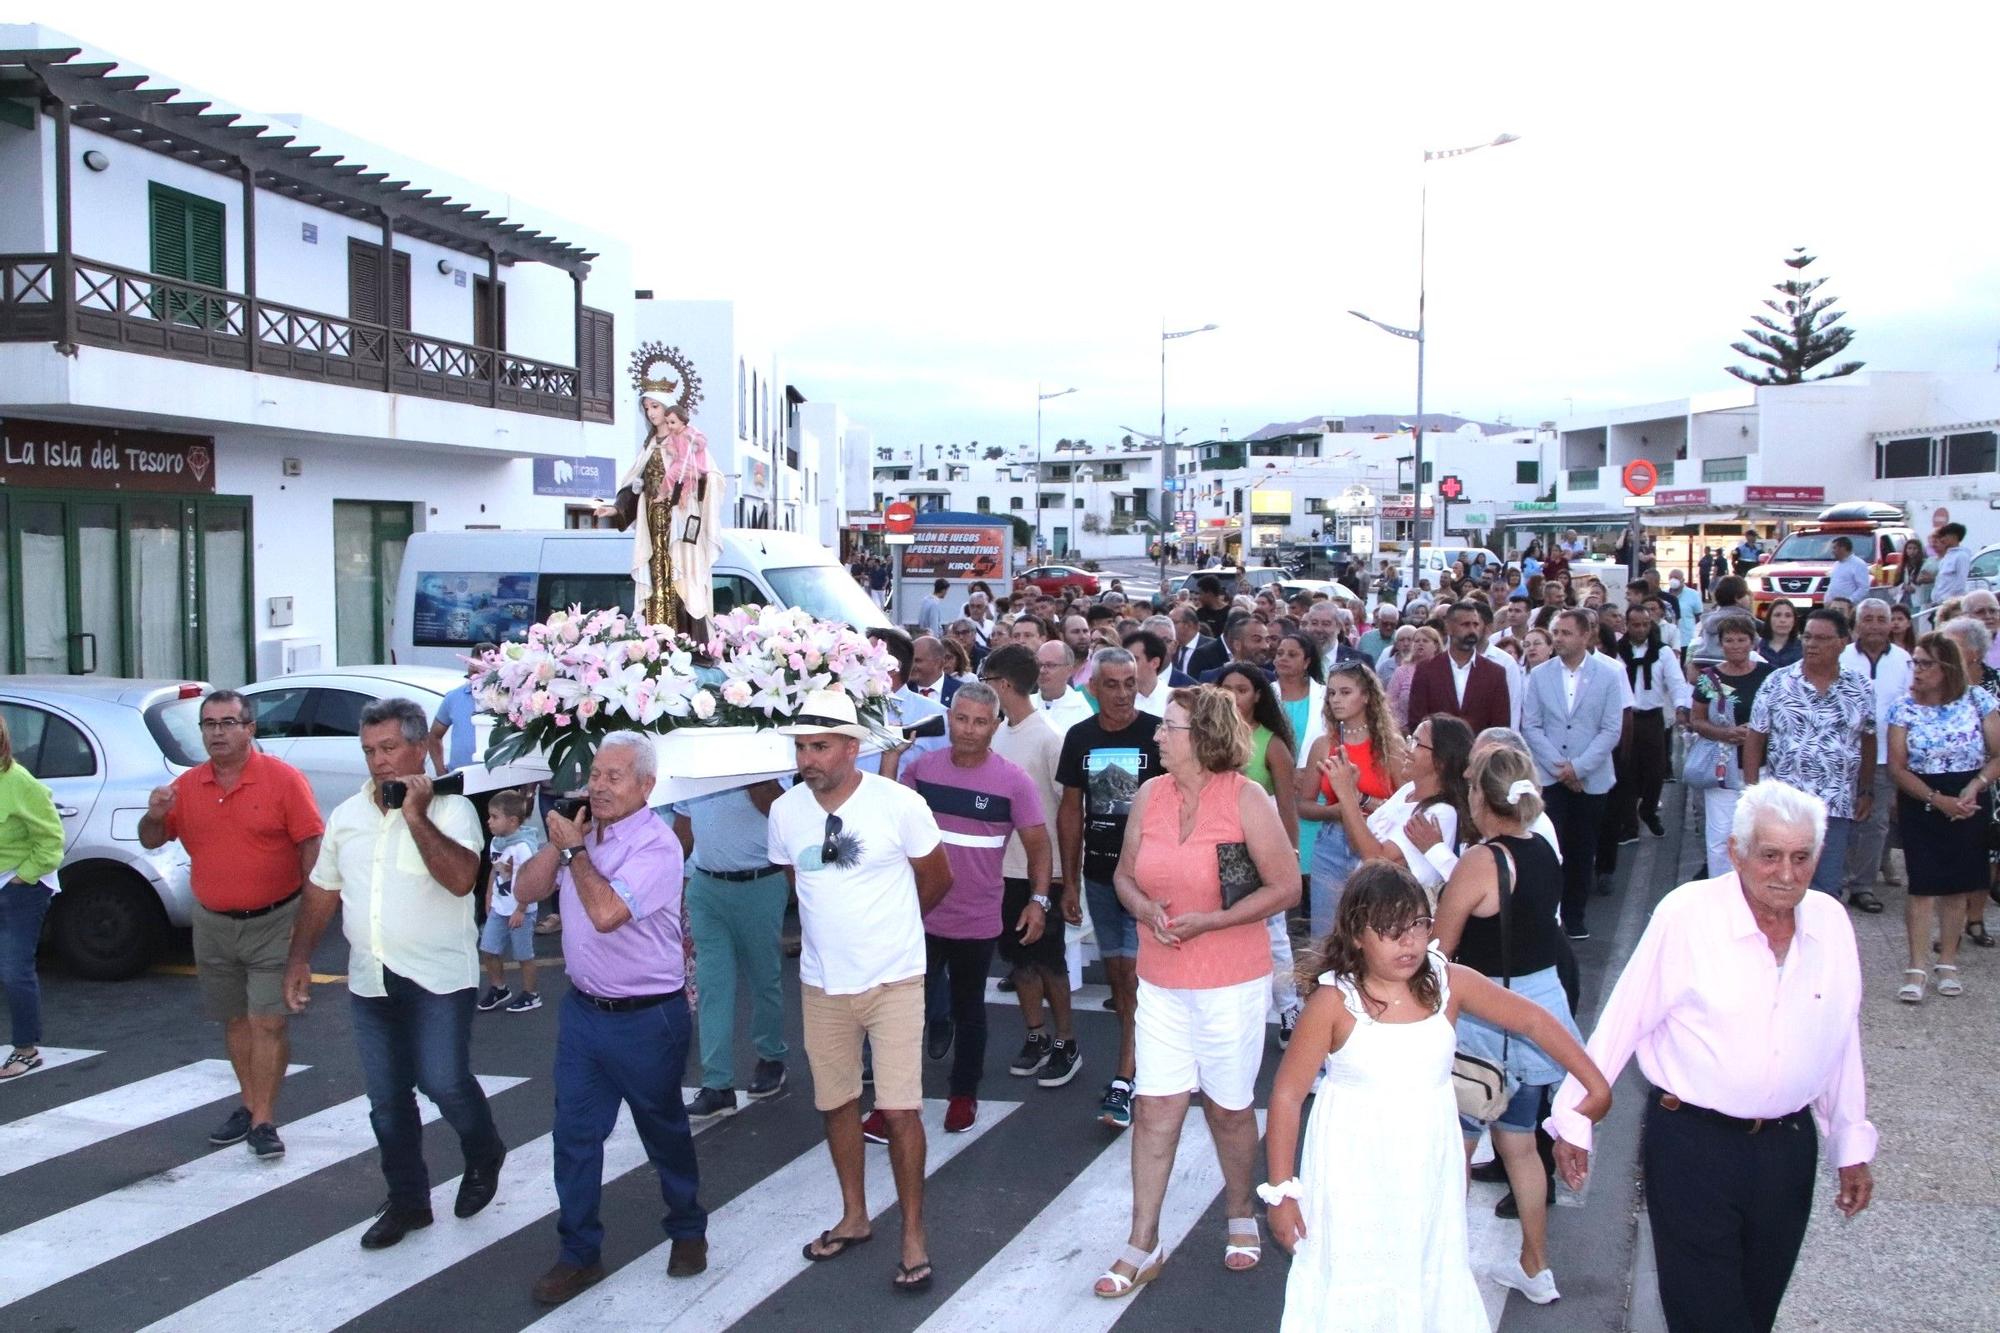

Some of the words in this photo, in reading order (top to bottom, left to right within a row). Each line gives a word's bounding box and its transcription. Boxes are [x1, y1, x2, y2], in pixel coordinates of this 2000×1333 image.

[5, 436, 35, 465] La
[44, 440, 82, 467] Isla
[91, 439, 120, 470] del
[125, 448, 184, 474] Tesoro
[938, 533, 949, 542] DE
[950, 533, 980, 543] JUEGOS
[905, 545, 949, 554] APUESTAS
[948, 546, 1000, 555] DEPORTIVAS
